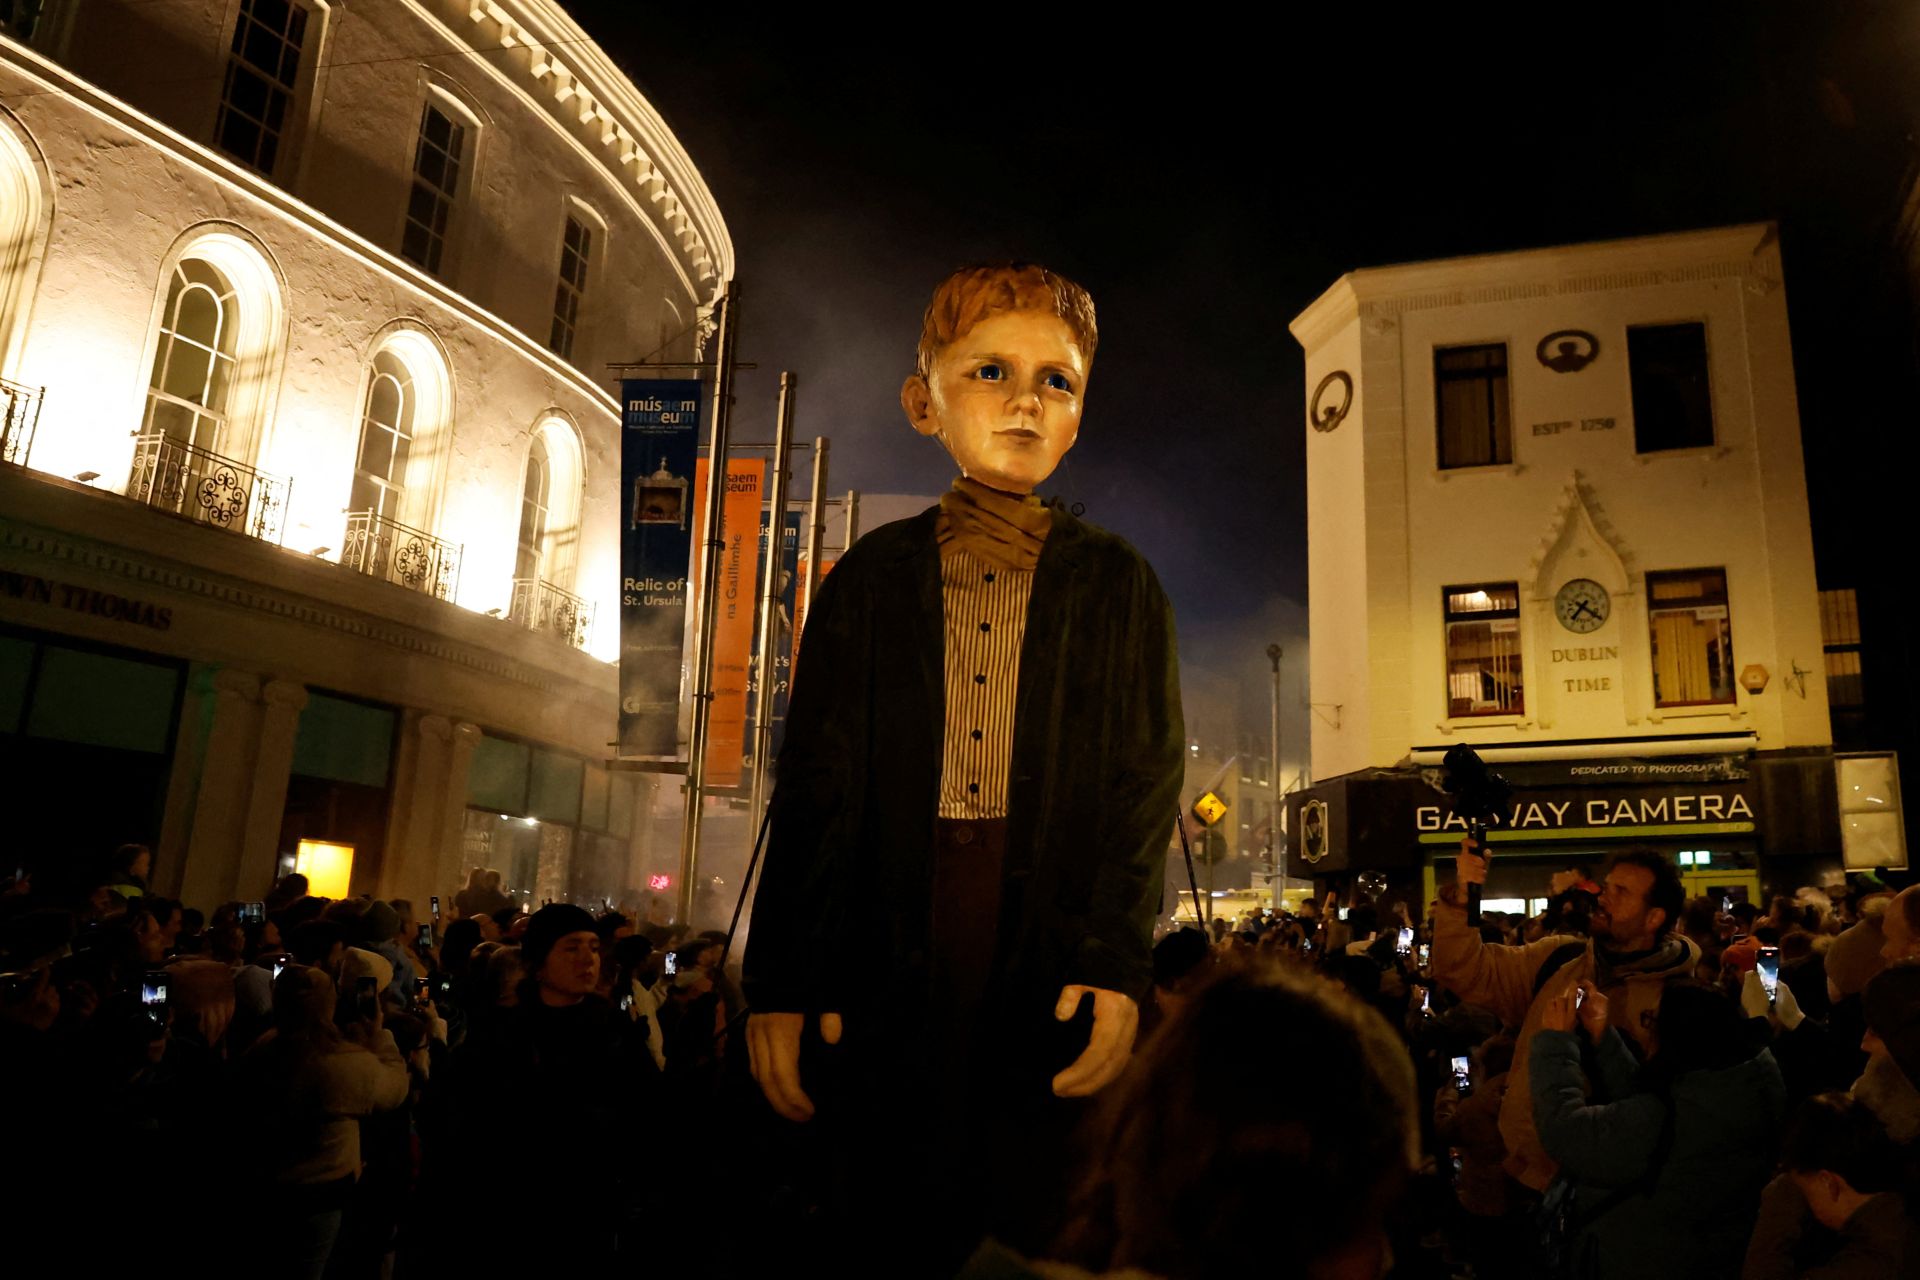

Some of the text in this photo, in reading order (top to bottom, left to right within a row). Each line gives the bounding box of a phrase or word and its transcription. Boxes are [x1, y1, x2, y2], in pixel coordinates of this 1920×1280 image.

[629, 396, 695, 412] músaem
[628, 411, 694, 424] museum
[624, 578, 685, 591] Relic of
[61, 583, 173, 630] THOMAS
[624, 595, 682, 606] St. Ursula
[1552, 646, 1618, 662] DUBLIN
[1563, 677, 1611, 692] TIME
[1571, 764, 1628, 775] DEDICATED
[1632, 763, 1646, 773] TO
[1417, 794, 1755, 830] GAAY CAMERA
